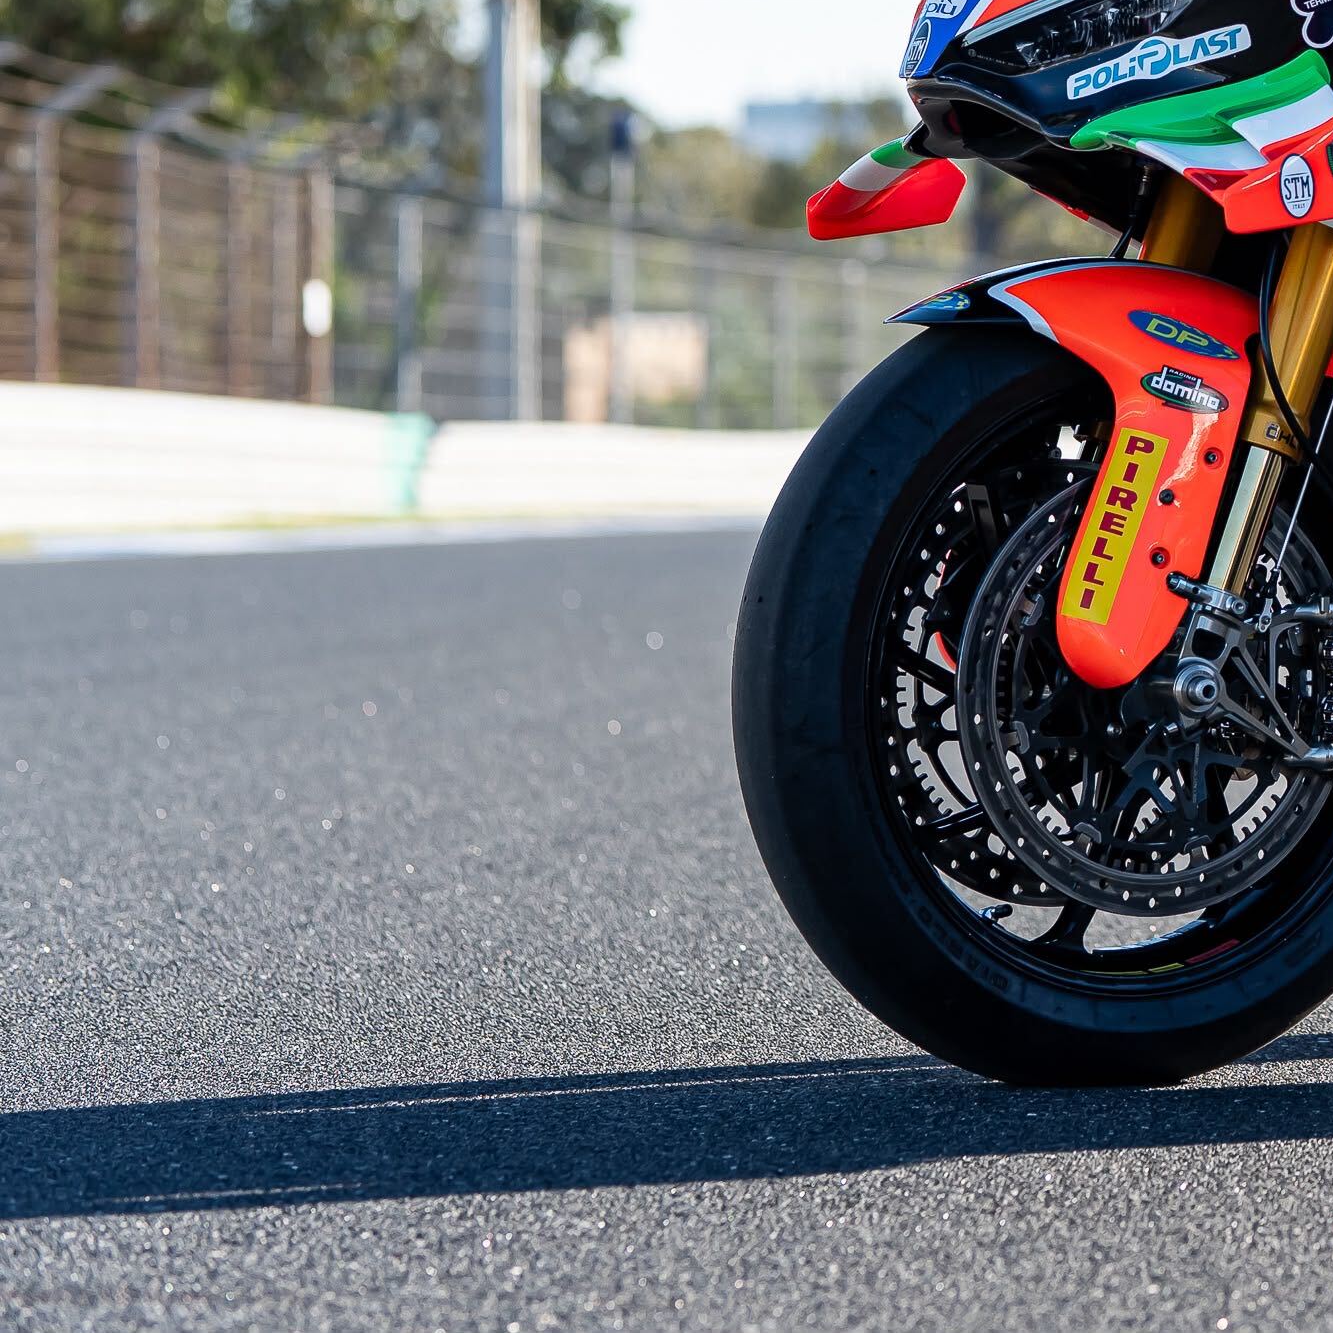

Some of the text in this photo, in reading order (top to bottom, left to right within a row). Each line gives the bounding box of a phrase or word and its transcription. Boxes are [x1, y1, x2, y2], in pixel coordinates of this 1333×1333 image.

[1283, 175, 1312, 200] STM
[1146, 317, 1209, 347] DP
[1151, 366, 1220, 410] domino
[1169, 369, 1197, 381] RACING
[1079, 434, 1156, 610] PIRELLI
